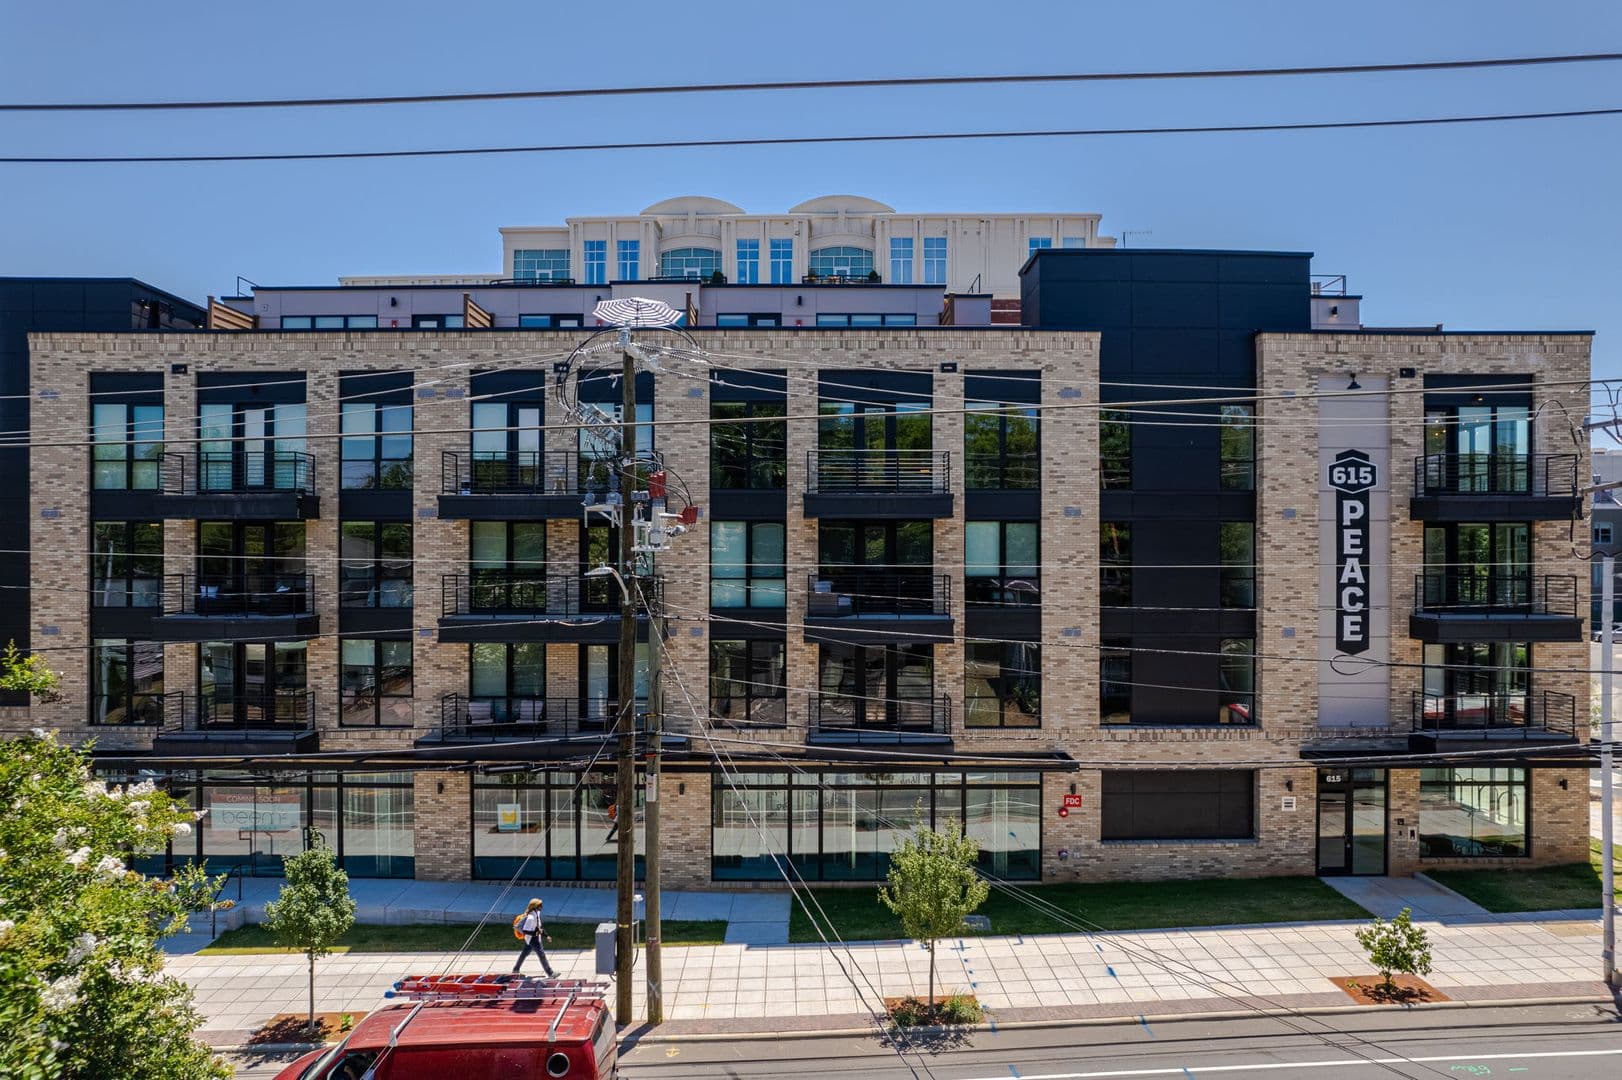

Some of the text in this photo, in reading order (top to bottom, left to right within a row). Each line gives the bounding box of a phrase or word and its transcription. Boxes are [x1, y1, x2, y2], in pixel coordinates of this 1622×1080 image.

[1332, 466, 1373, 485] 615
[1339, 499, 1366, 642] PEACE
[1325, 775, 1342, 783] 615
[1065, 797, 1080, 805] FDC
